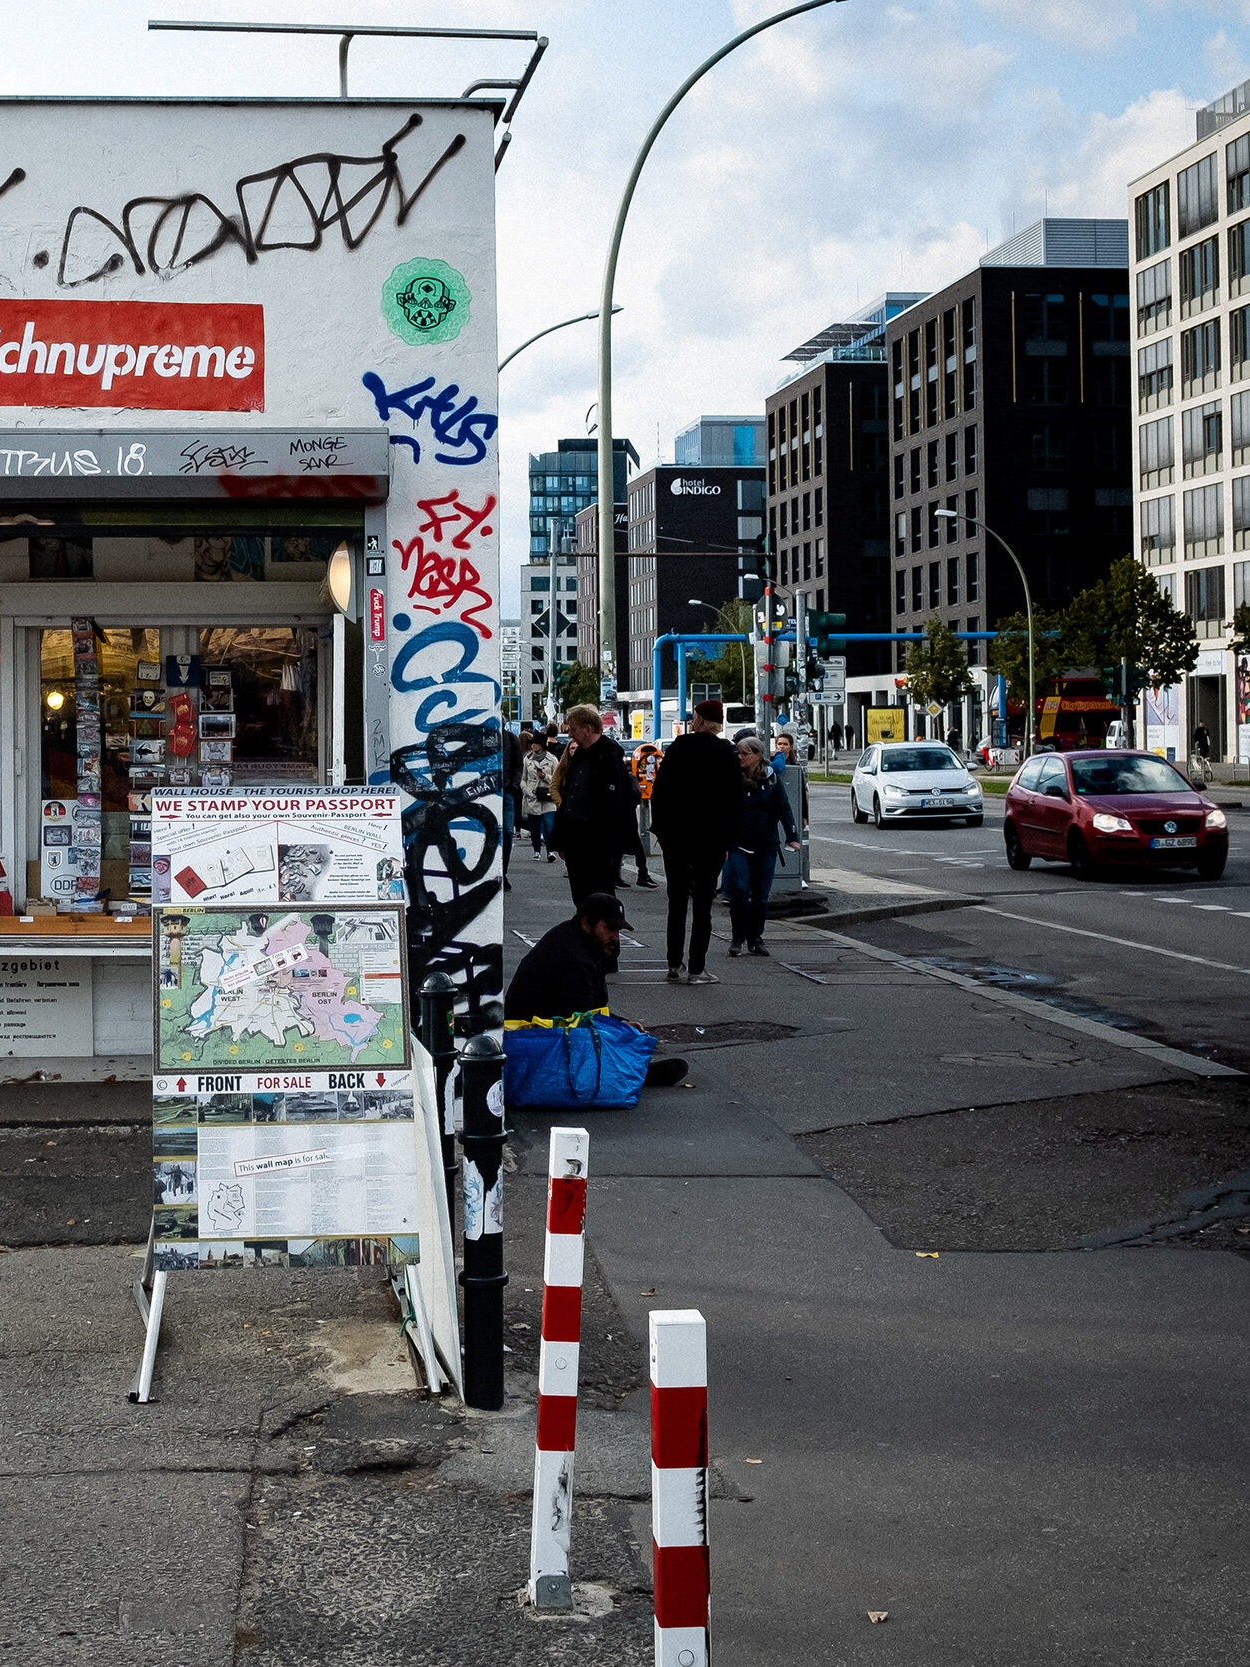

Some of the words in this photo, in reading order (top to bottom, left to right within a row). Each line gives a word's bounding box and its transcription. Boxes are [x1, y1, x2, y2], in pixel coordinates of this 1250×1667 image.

[289, 436, 348, 455] MONGE
[682, 478, 705, 487] hotel
[682, 485, 721, 495] INDIGO
[373, 592, 383, 610] Fuck
[372, 612, 383, 637] Trump
[154, 788, 187, 796] WALL
[190, 788, 233, 796] HOUSE
[243, 787, 268, 795] THE
[270, 787, 323, 795] TOURIST
[325, 787, 358, 795] SHOP
[360, 786, 396, 794] HERE!
[155, 800, 183, 812] WE
[187, 800, 248, 811] STAMP
[251, 799, 300, 811] YOUR
[306, 799, 396, 811] PASSPORT
[197, 1075, 242, 1092] FRONT
[257, 1077, 280, 1089] FOR
[283, 1076, 312, 1089] SALE
[328, 1073, 365, 1090] BACK
[238, 1164, 255, 1174] This
[256, 1160, 273, 1171] wall
[274, 1158, 294, 1169] map
[294, 1156, 301, 1164] is
[302, 1154, 314, 1163] for
